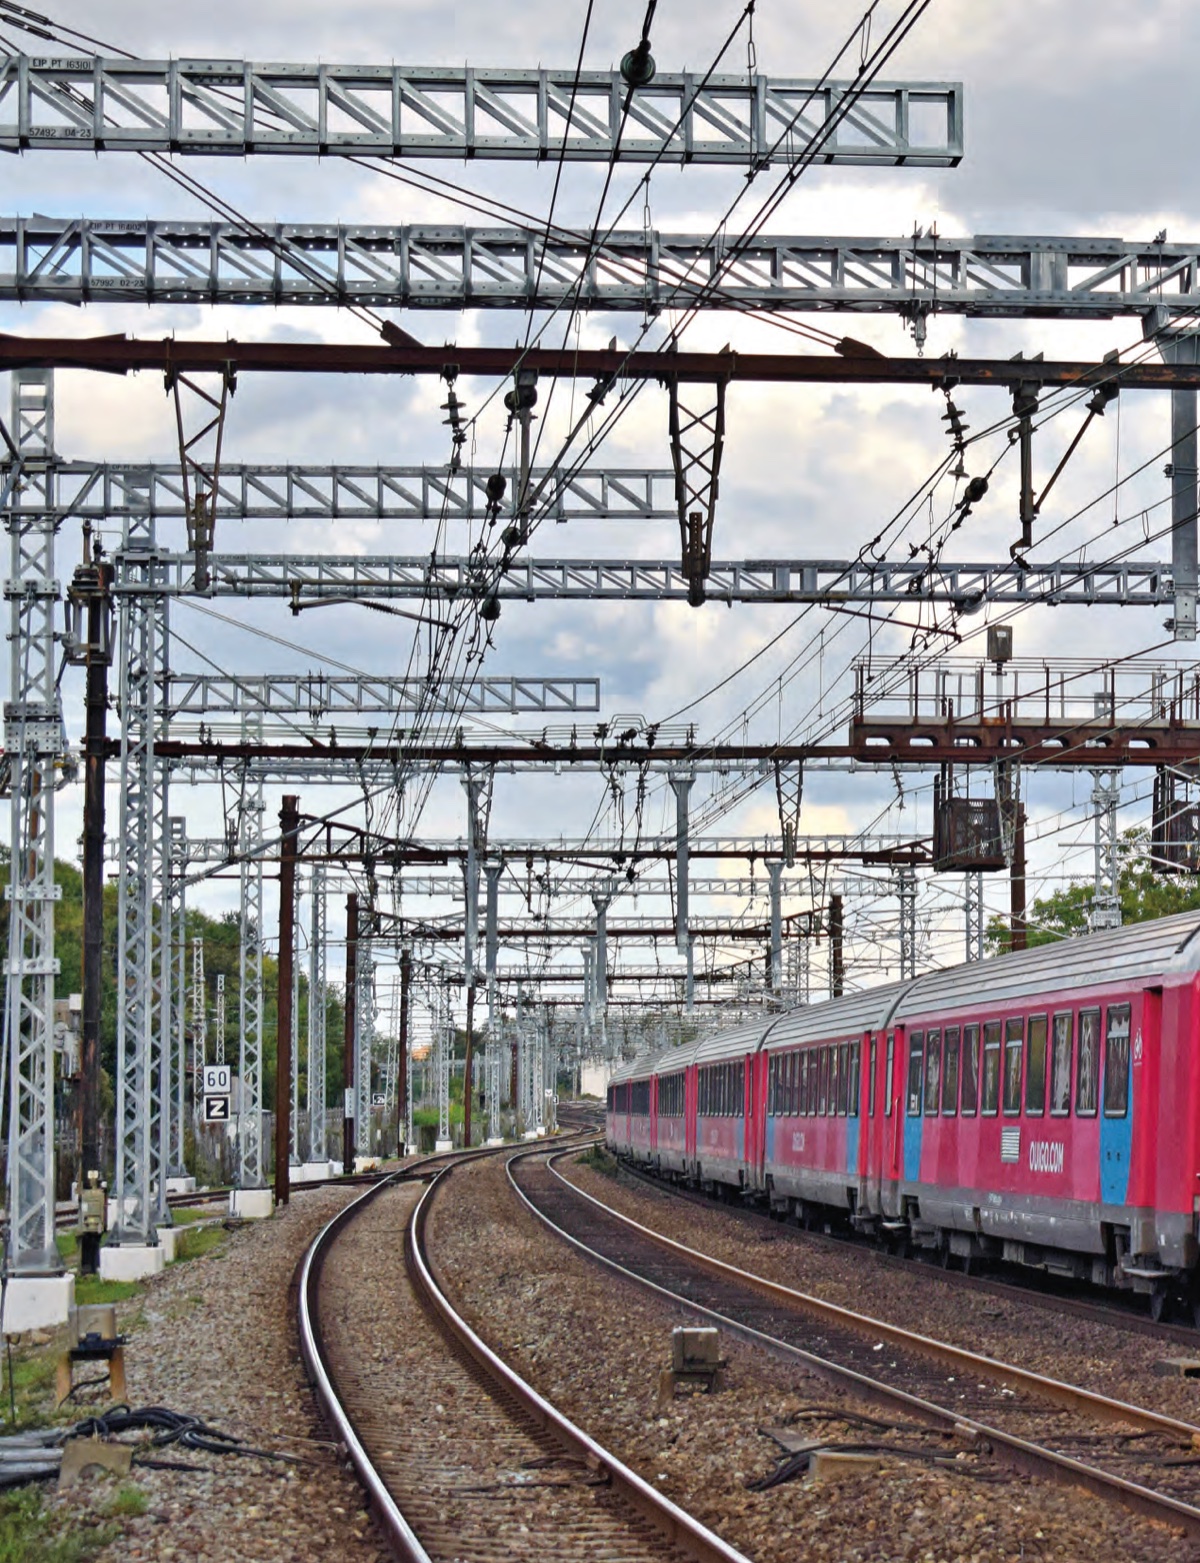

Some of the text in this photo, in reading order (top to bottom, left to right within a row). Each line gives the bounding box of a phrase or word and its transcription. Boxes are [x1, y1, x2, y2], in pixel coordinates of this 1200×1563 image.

[51, 60, 62, 68] PT
[207, 1070, 227, 1087] 60
[210, 1100, 225, 1117] Z
[1029, 1141, 1064, 1173] OUIGO.COM
